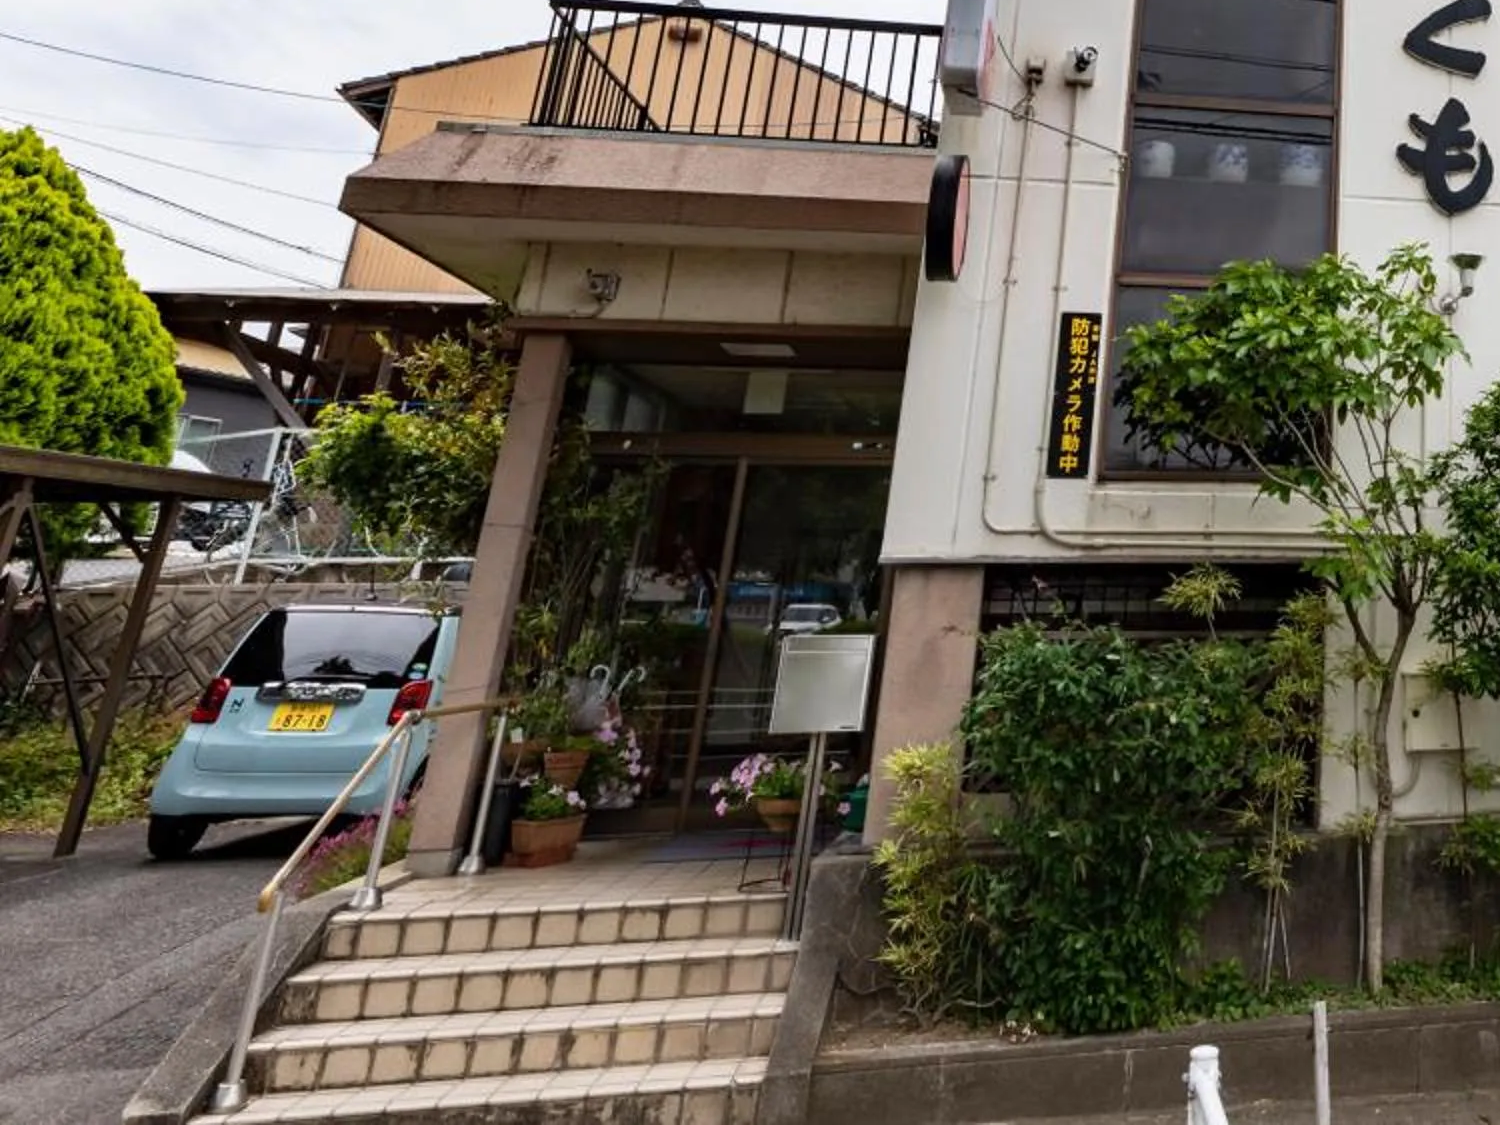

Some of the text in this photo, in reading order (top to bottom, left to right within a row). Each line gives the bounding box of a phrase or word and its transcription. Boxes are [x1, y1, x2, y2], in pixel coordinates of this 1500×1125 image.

[1058, 317, 1091, 474] 防犯カメラ作動中
